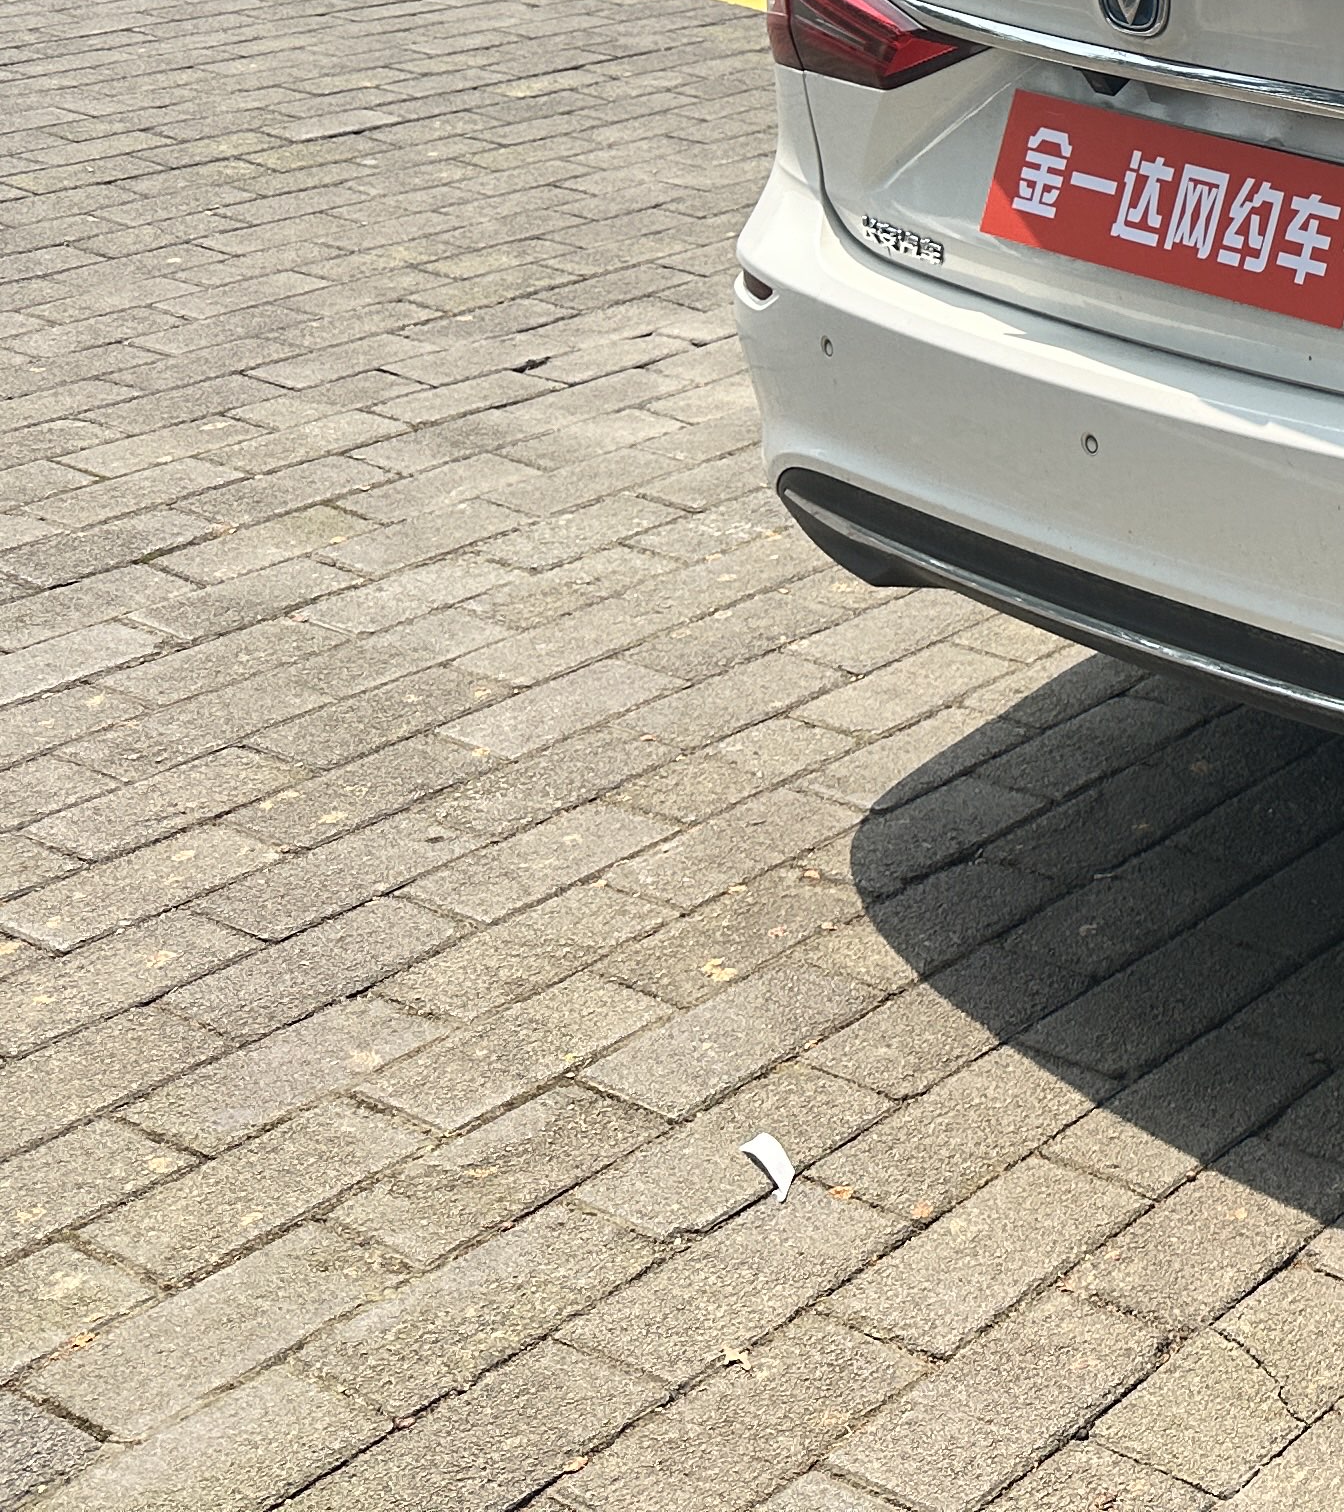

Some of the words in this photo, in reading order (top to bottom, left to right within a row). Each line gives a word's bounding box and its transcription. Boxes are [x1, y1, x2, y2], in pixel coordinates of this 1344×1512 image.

[1011, 125, 1343, 287] 金一达网约车
